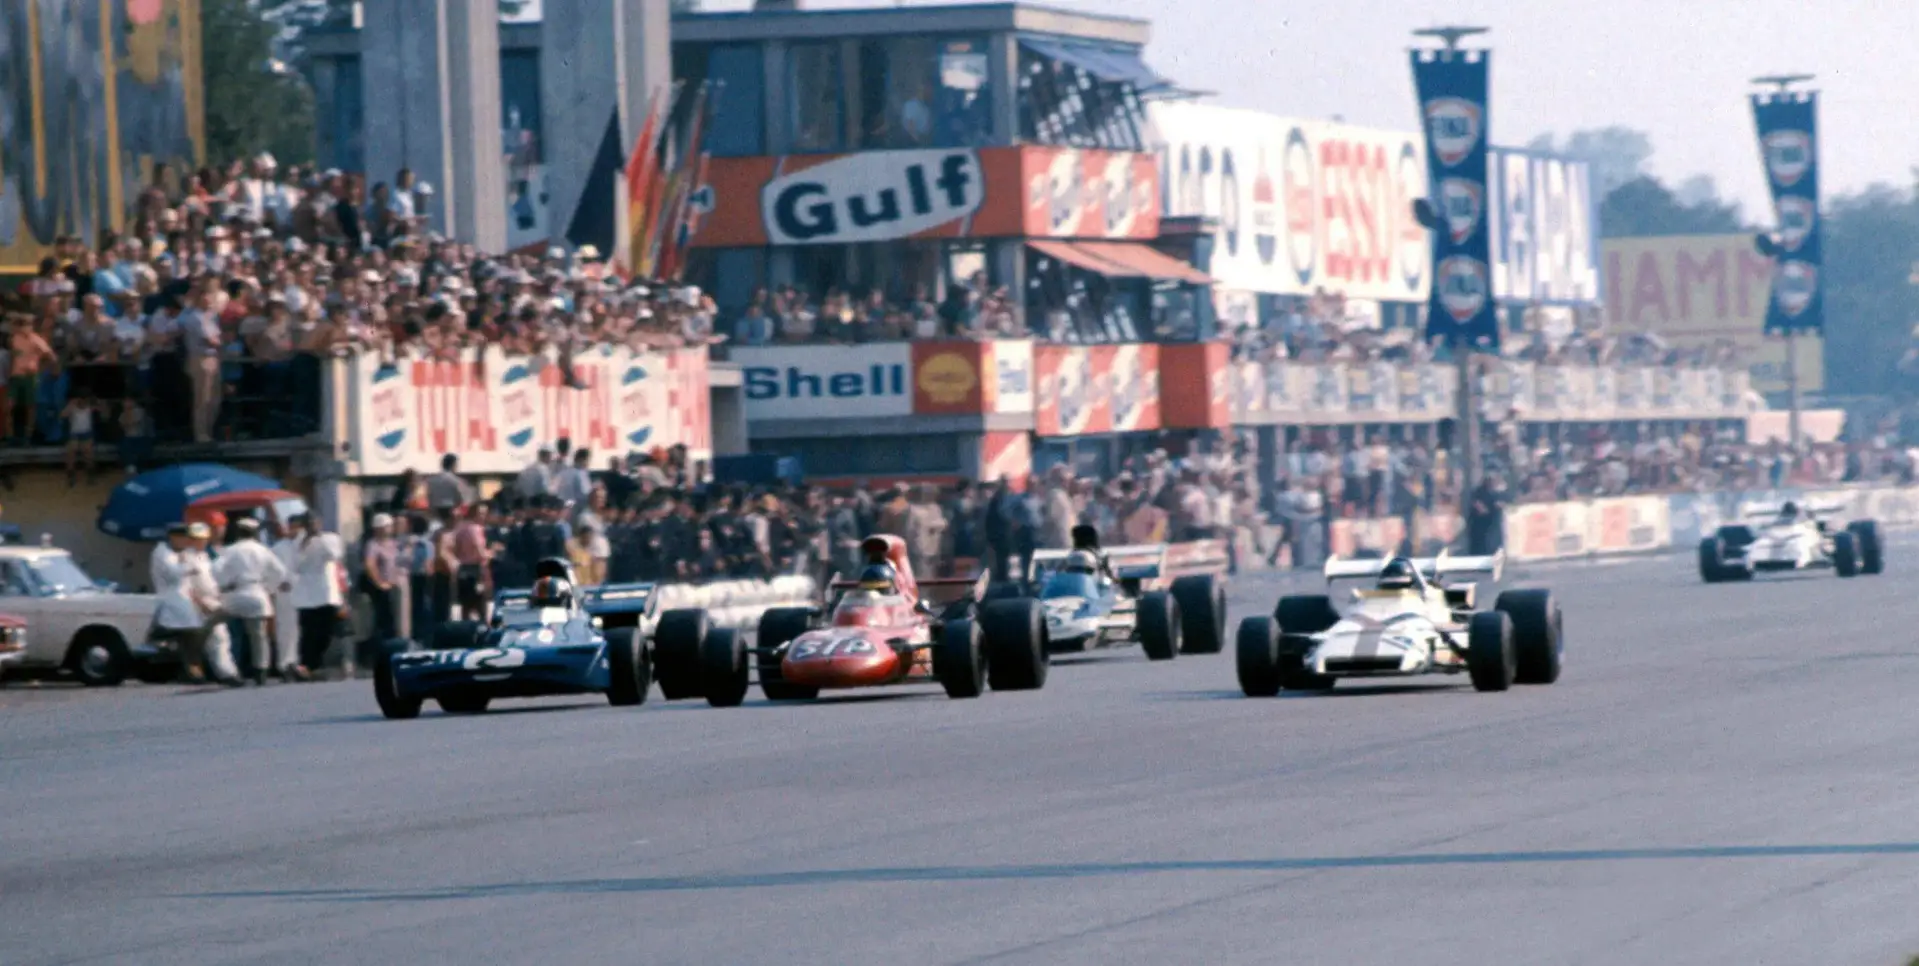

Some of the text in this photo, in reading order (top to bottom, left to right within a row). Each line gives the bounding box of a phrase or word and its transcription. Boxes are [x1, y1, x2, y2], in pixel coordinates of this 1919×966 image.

[773, 154, 972, 239] Gulf
[1319, 139, 1391, 283] ESSO
[743, 363, 906, 400] Shell
[795, 636, 873, 659] STP
